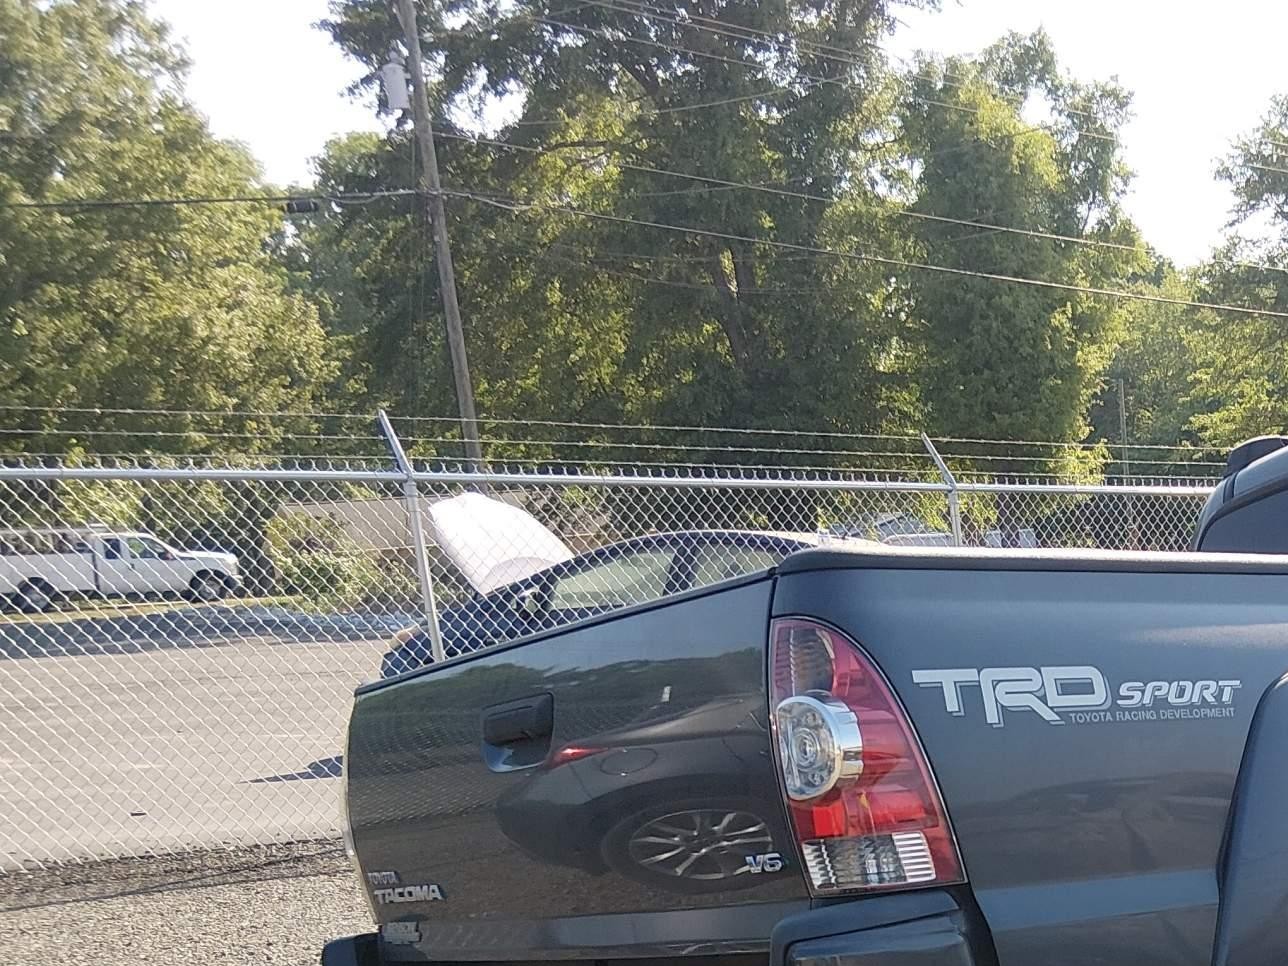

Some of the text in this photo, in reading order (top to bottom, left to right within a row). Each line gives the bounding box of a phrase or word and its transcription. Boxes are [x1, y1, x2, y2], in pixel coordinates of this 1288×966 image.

[912, 666, 1242, 728] TRD SPORT
[1069, 707, 1236, 724] TOYOTA RACING DEVELOPMENT
[745, 853, 783, 874] V6
[374, 884, 443, 904] TACOMA
